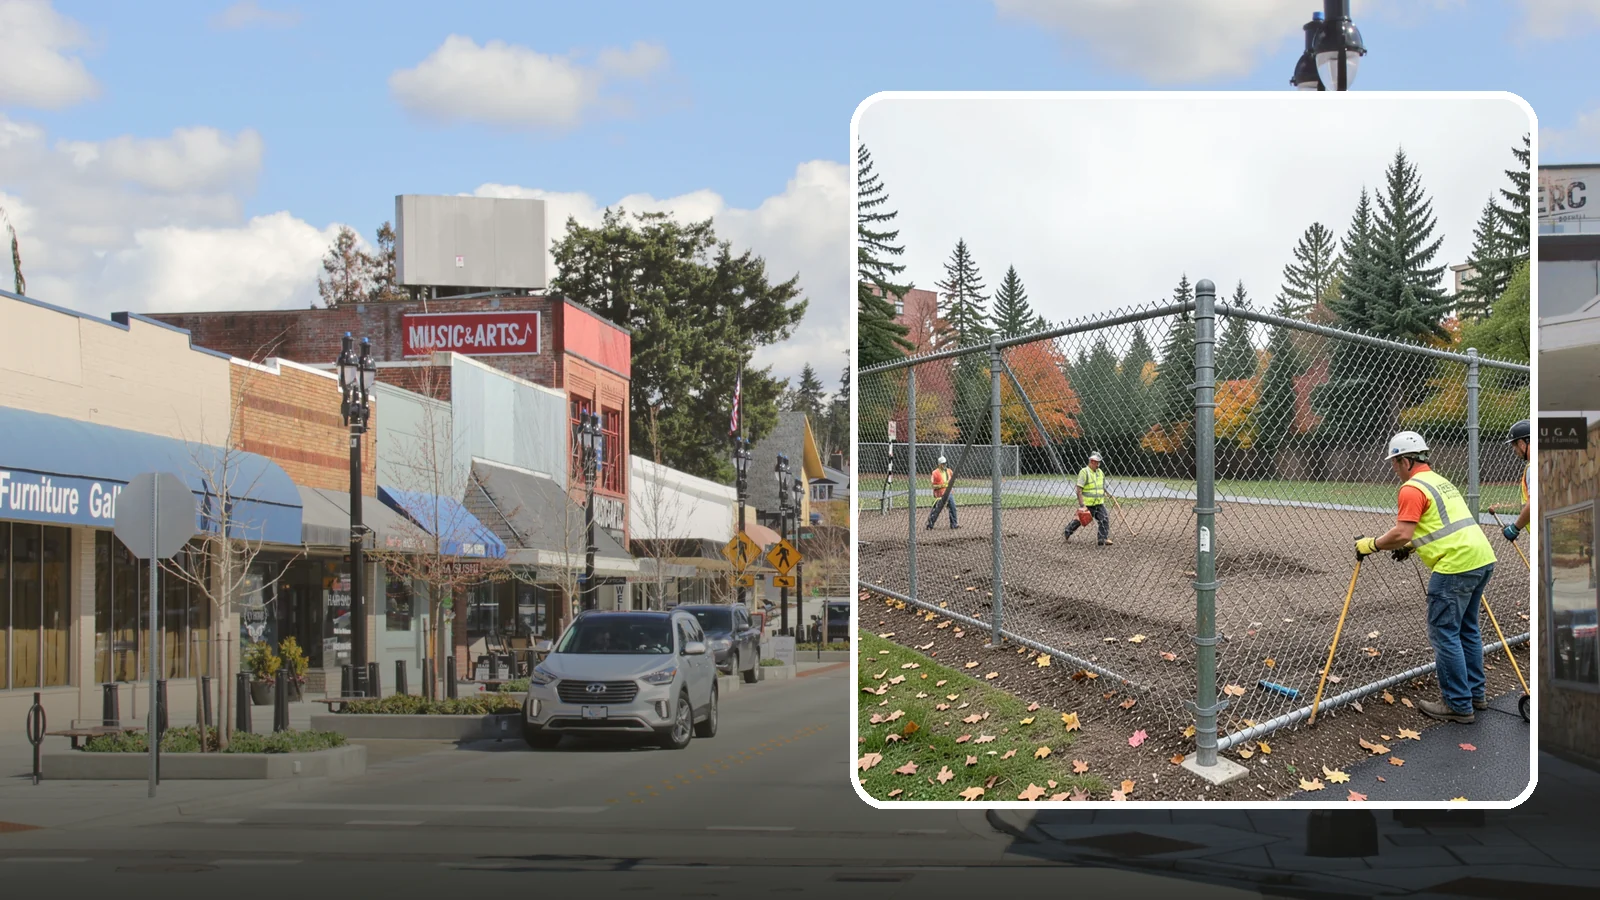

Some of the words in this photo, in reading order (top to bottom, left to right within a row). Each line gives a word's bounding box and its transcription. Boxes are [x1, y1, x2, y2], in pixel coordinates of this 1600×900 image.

[0, 471, 79, 515] Furniture
[89, 482, 122, 519] Gal
[453, 562, 479, 573] SUSHI
